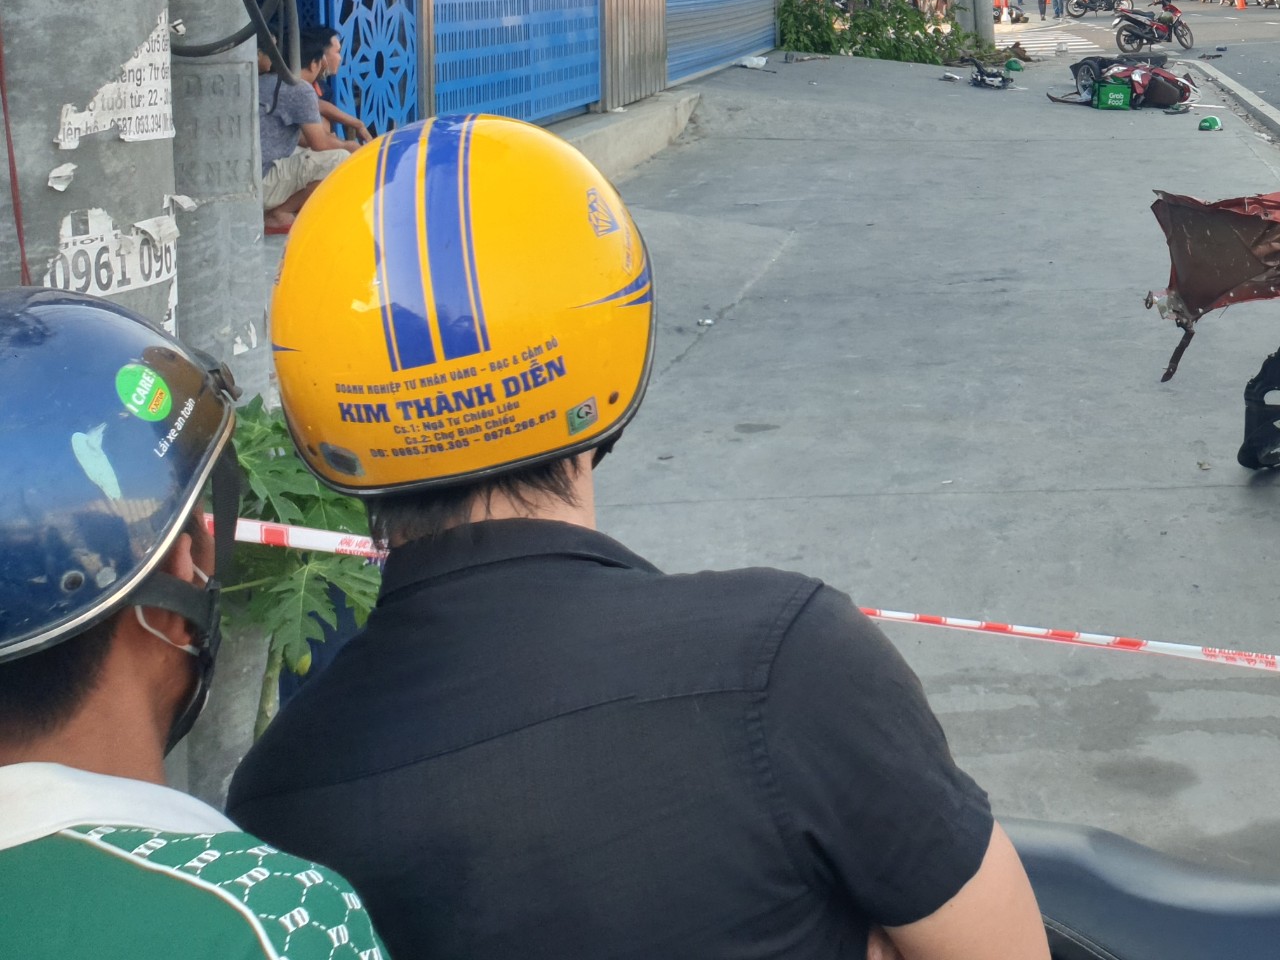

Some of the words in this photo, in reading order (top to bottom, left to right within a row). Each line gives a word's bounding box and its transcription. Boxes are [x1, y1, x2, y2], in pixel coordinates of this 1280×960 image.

[101, 88, 127, 112] tuổi
[130, 91, 145, 109] từ:
[148, 89, 158, 107] 22
[1108, 92, 1124, 100] Grab
[50, 243, 132, 293] 0961
[335, 383, 364, 395] DOANH
[366, 381, 401, 395] NGHIỆP
[418, 373, 447, 388] NHÂN
[449, 366, 477, 381] VÀNG
[489, 358, 510, 372] BẠC
[512, 354, 519, 365] &
[521, 345, 544, 361] CẦM
[338, 402, 391, 424] KIM
[395, 382, 496, 422] THÀNH
[501, 355, 567, 399] DIỄN
[126, 403, 139, 413] I
[153, 438, 170, 458] Lái
[166, 428, 180, 443] xe
[174, 416, 186, 431] an
[180, 397, 196, 419] toàn
[278, 905, 311, 934] YD
[326, 923, 350, 949] YD
